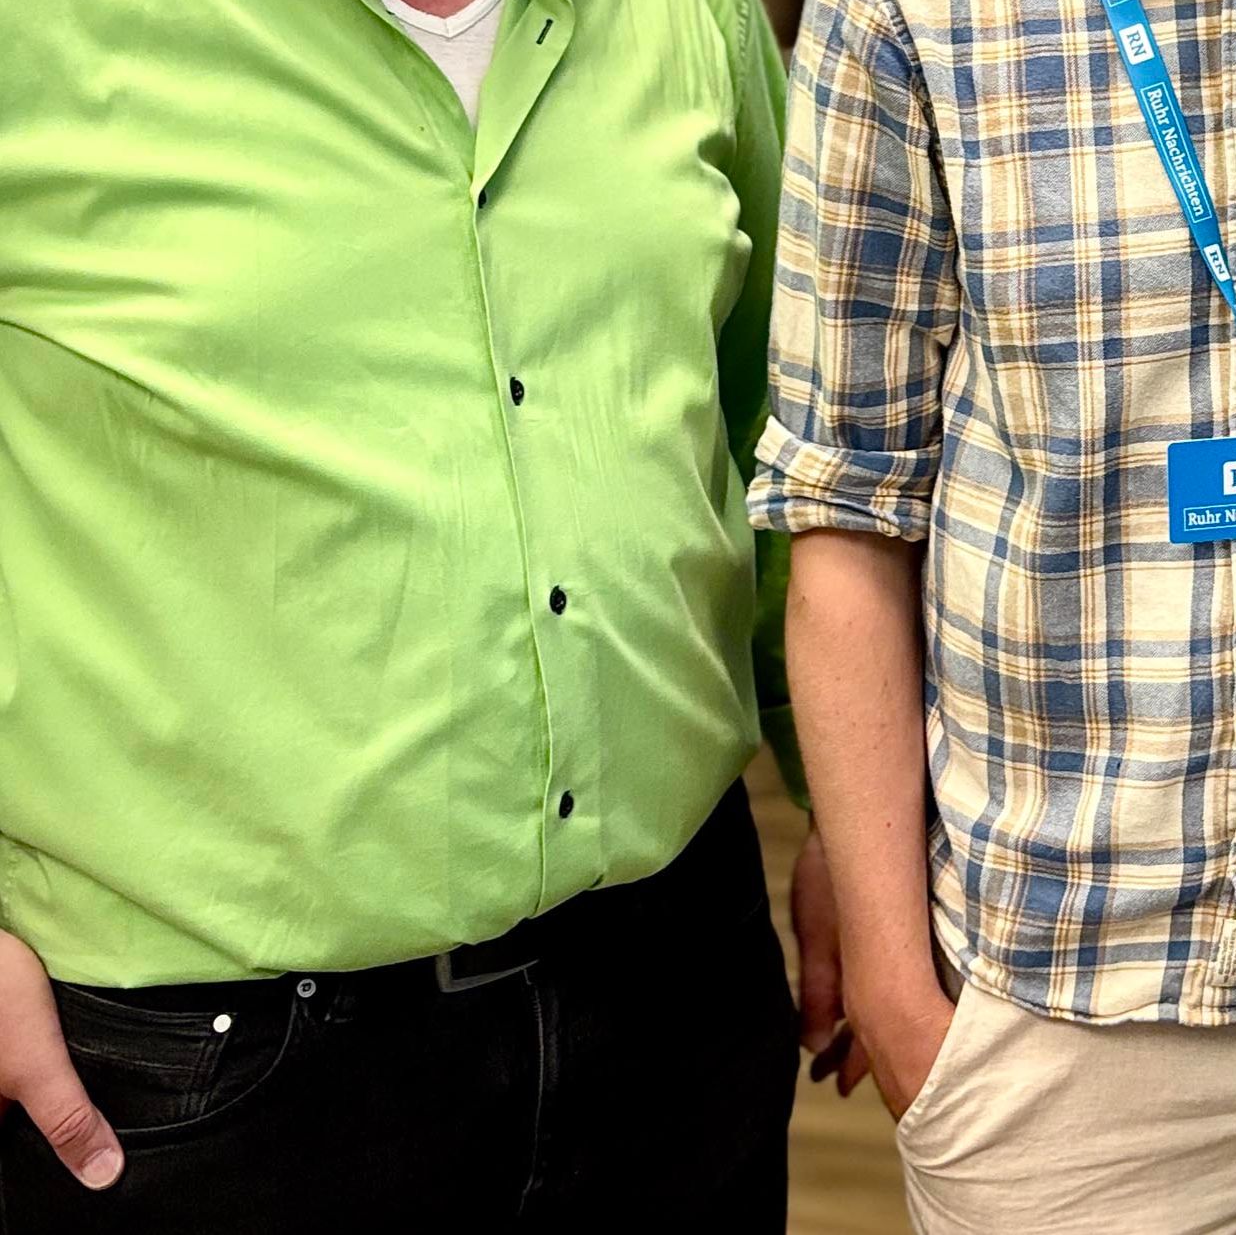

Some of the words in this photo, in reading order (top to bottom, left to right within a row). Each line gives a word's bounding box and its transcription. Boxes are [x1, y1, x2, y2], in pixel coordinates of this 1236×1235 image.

[1126, 29, 1147, 58] RN
[1147, 88, 1170, 126] Ruhr
[1163, 125, 1205, 217] Nachrichten
[1208, 250, 1226, 276] RN
[1188, 511, 1222, 526] Ruhr
